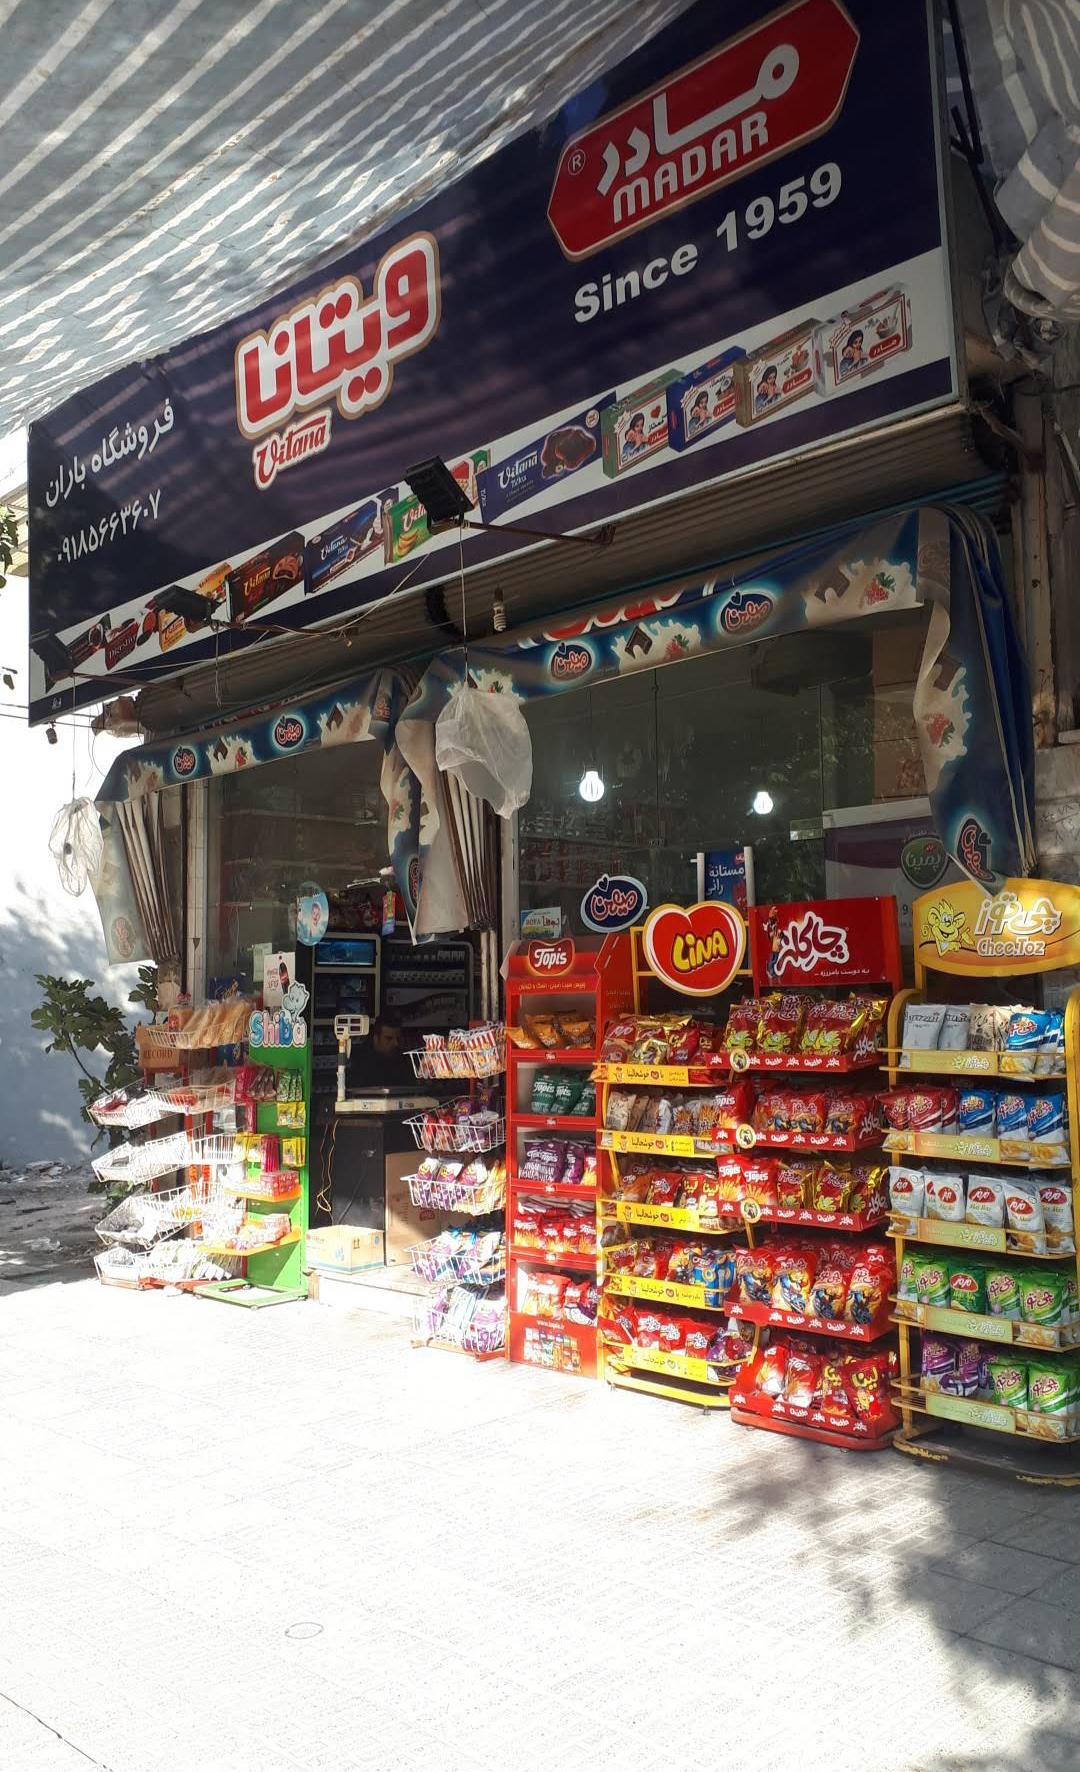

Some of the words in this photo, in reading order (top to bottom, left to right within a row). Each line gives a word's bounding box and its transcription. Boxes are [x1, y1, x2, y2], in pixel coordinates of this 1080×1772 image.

[597, 43, 800, 196] مادر
[612, 112, 770, 224] MADAR
[574, 243, 698, 323] Since
[716, 162, 842, 252] 1959
[240, 244, 434, 430] ویتانا
[91, 398, 175, 473] فروشگاه
[254, 412, 329, 487] Vitana
[45, 456, 86, 507] باران
[498, 450, 538, 489] Vitana
[590, 889, 639, 922] میهن
[534, 947, 568, 969] Topis
[250, 1010, 307, 1047] Shiba
[743, 1170, 768, 1183] Topis
